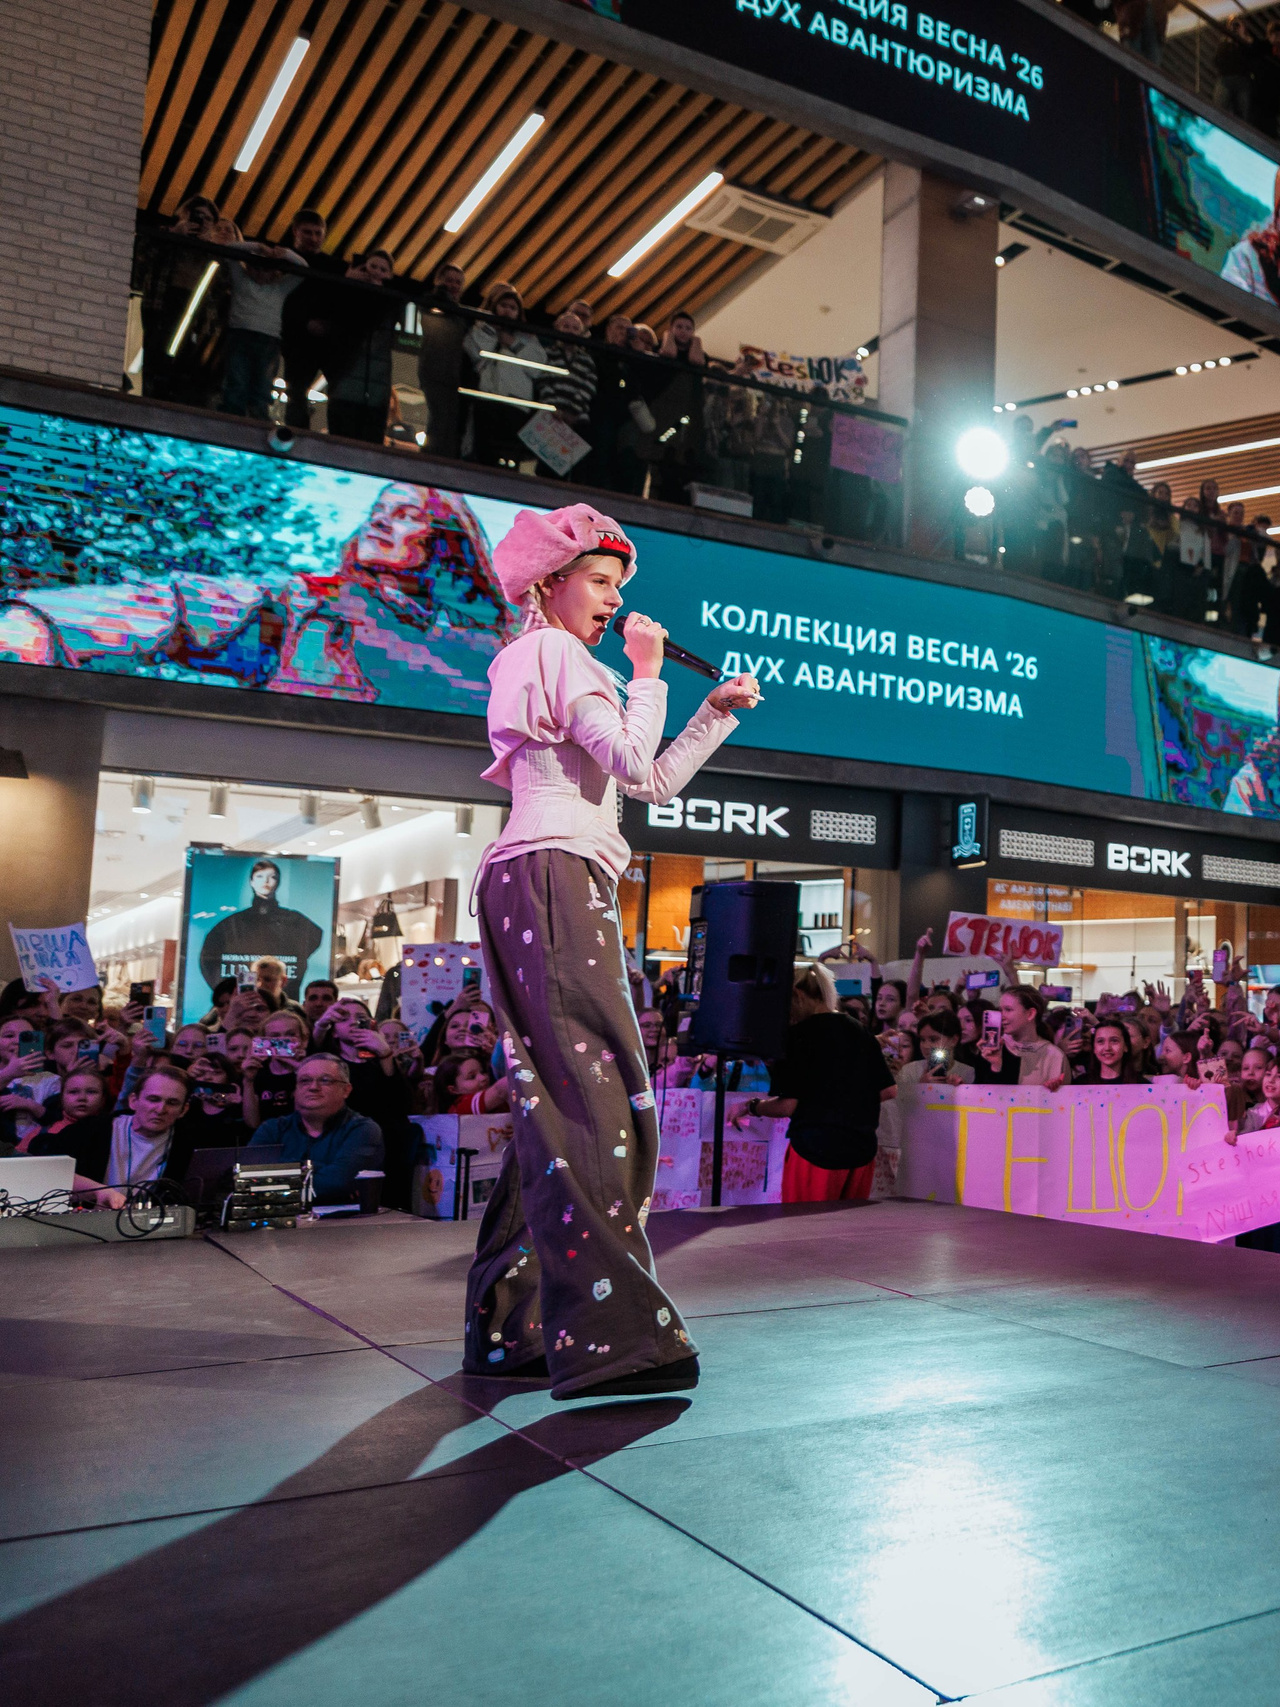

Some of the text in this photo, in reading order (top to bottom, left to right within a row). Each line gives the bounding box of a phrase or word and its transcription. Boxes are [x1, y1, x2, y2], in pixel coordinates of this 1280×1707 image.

[736, 0, 1030, 122] ДУХ АВАНТЮРИЗМА
[838, 0, 1044, 90] ЦИЯ ВЕСНА '26
[700, 600, 1039, 681] КОЛЛЕКЦИЯ ВЕСНА '26
[792, 661, 1025, 719] АВАНТЮРИЗМА
[648, 796, 790, 839] BORK
[1106, 841, 1192, 879] BORK
